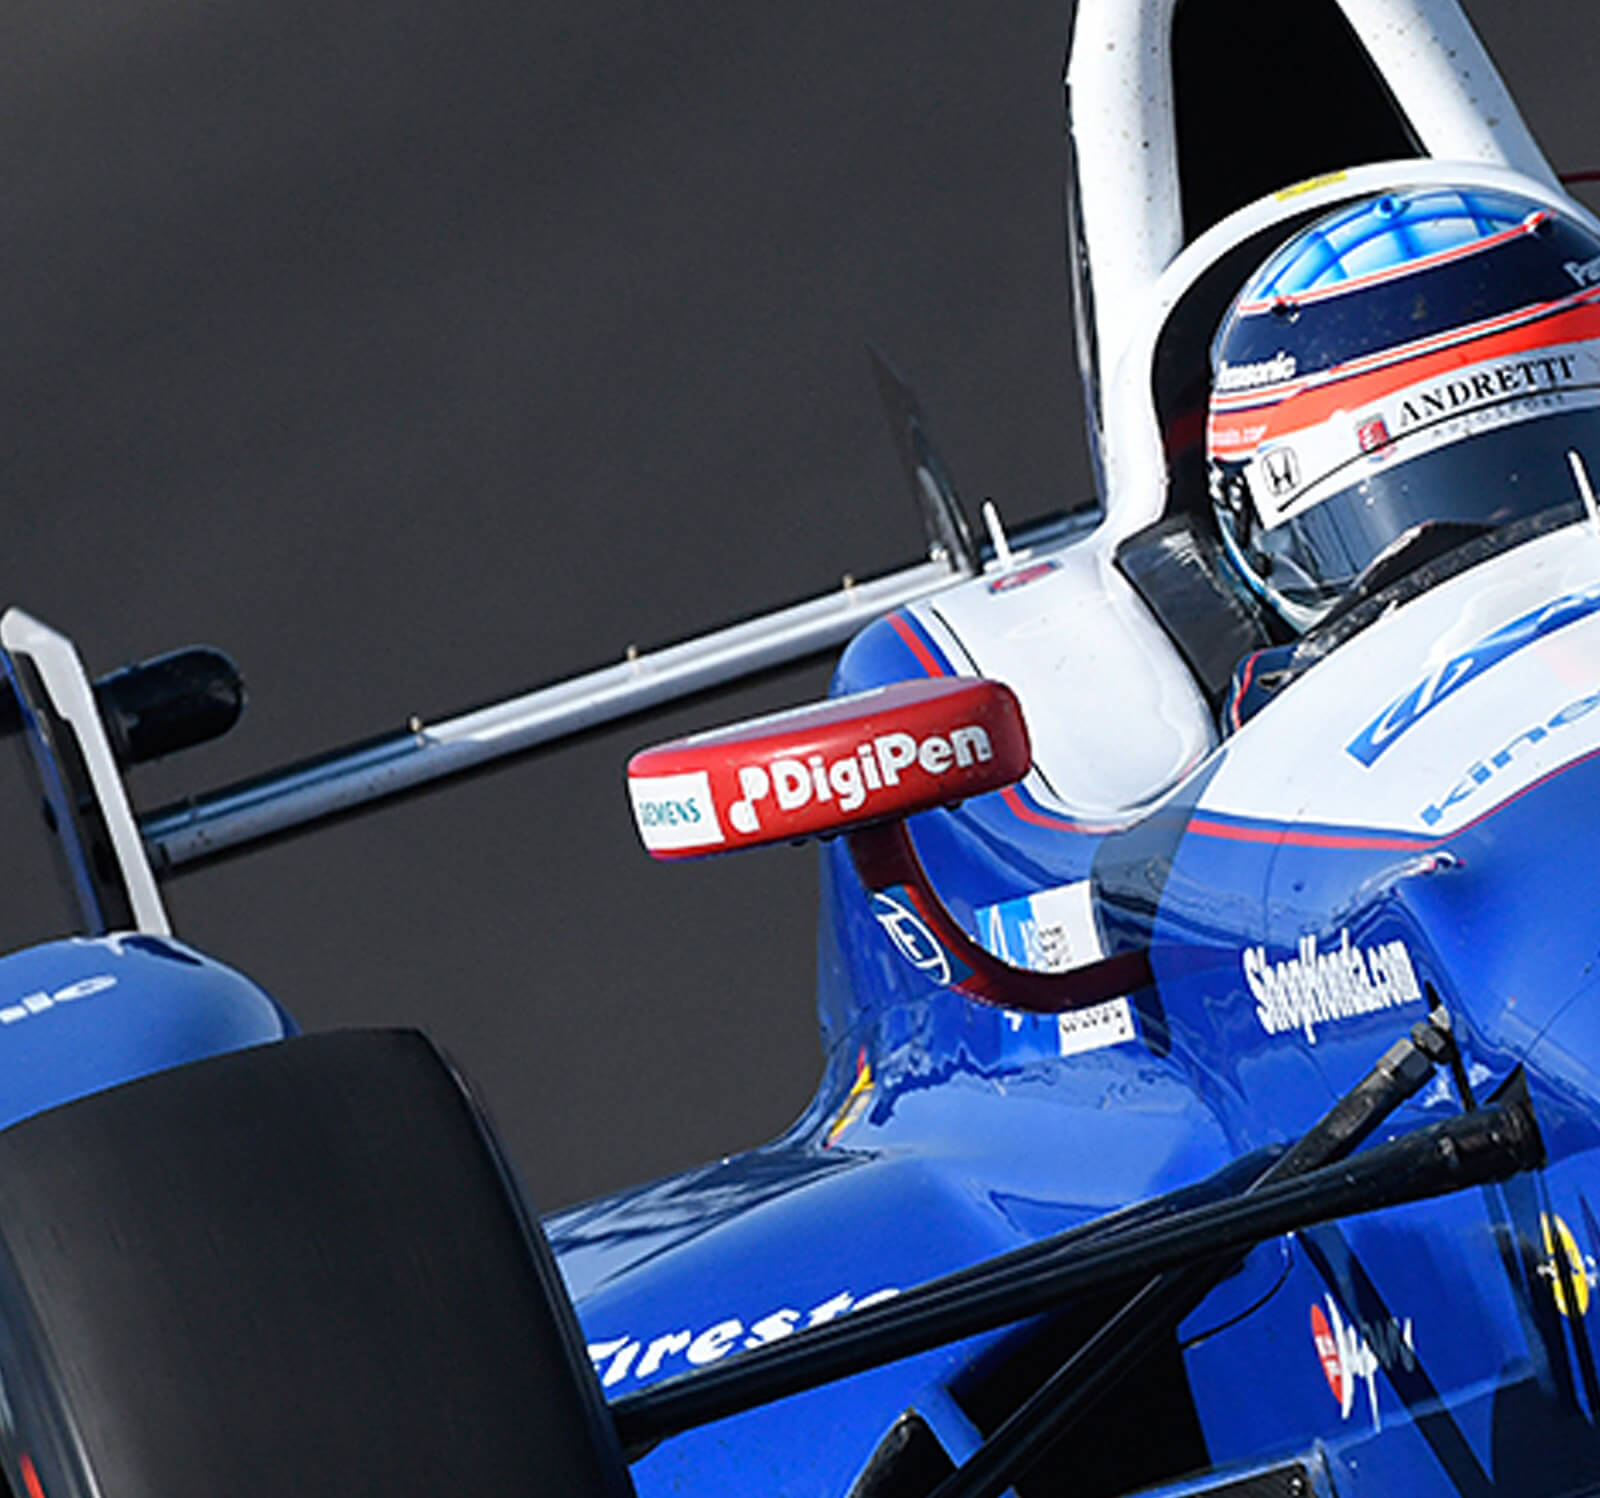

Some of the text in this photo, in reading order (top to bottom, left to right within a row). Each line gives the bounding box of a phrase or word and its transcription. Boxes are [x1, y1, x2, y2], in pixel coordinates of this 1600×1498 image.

[1398, 354, 1577, 427] ANDRETTI
[768, 724, 992, 812] DigiPen
[1242, 926, 1422, 1045] ShopHonda.com
